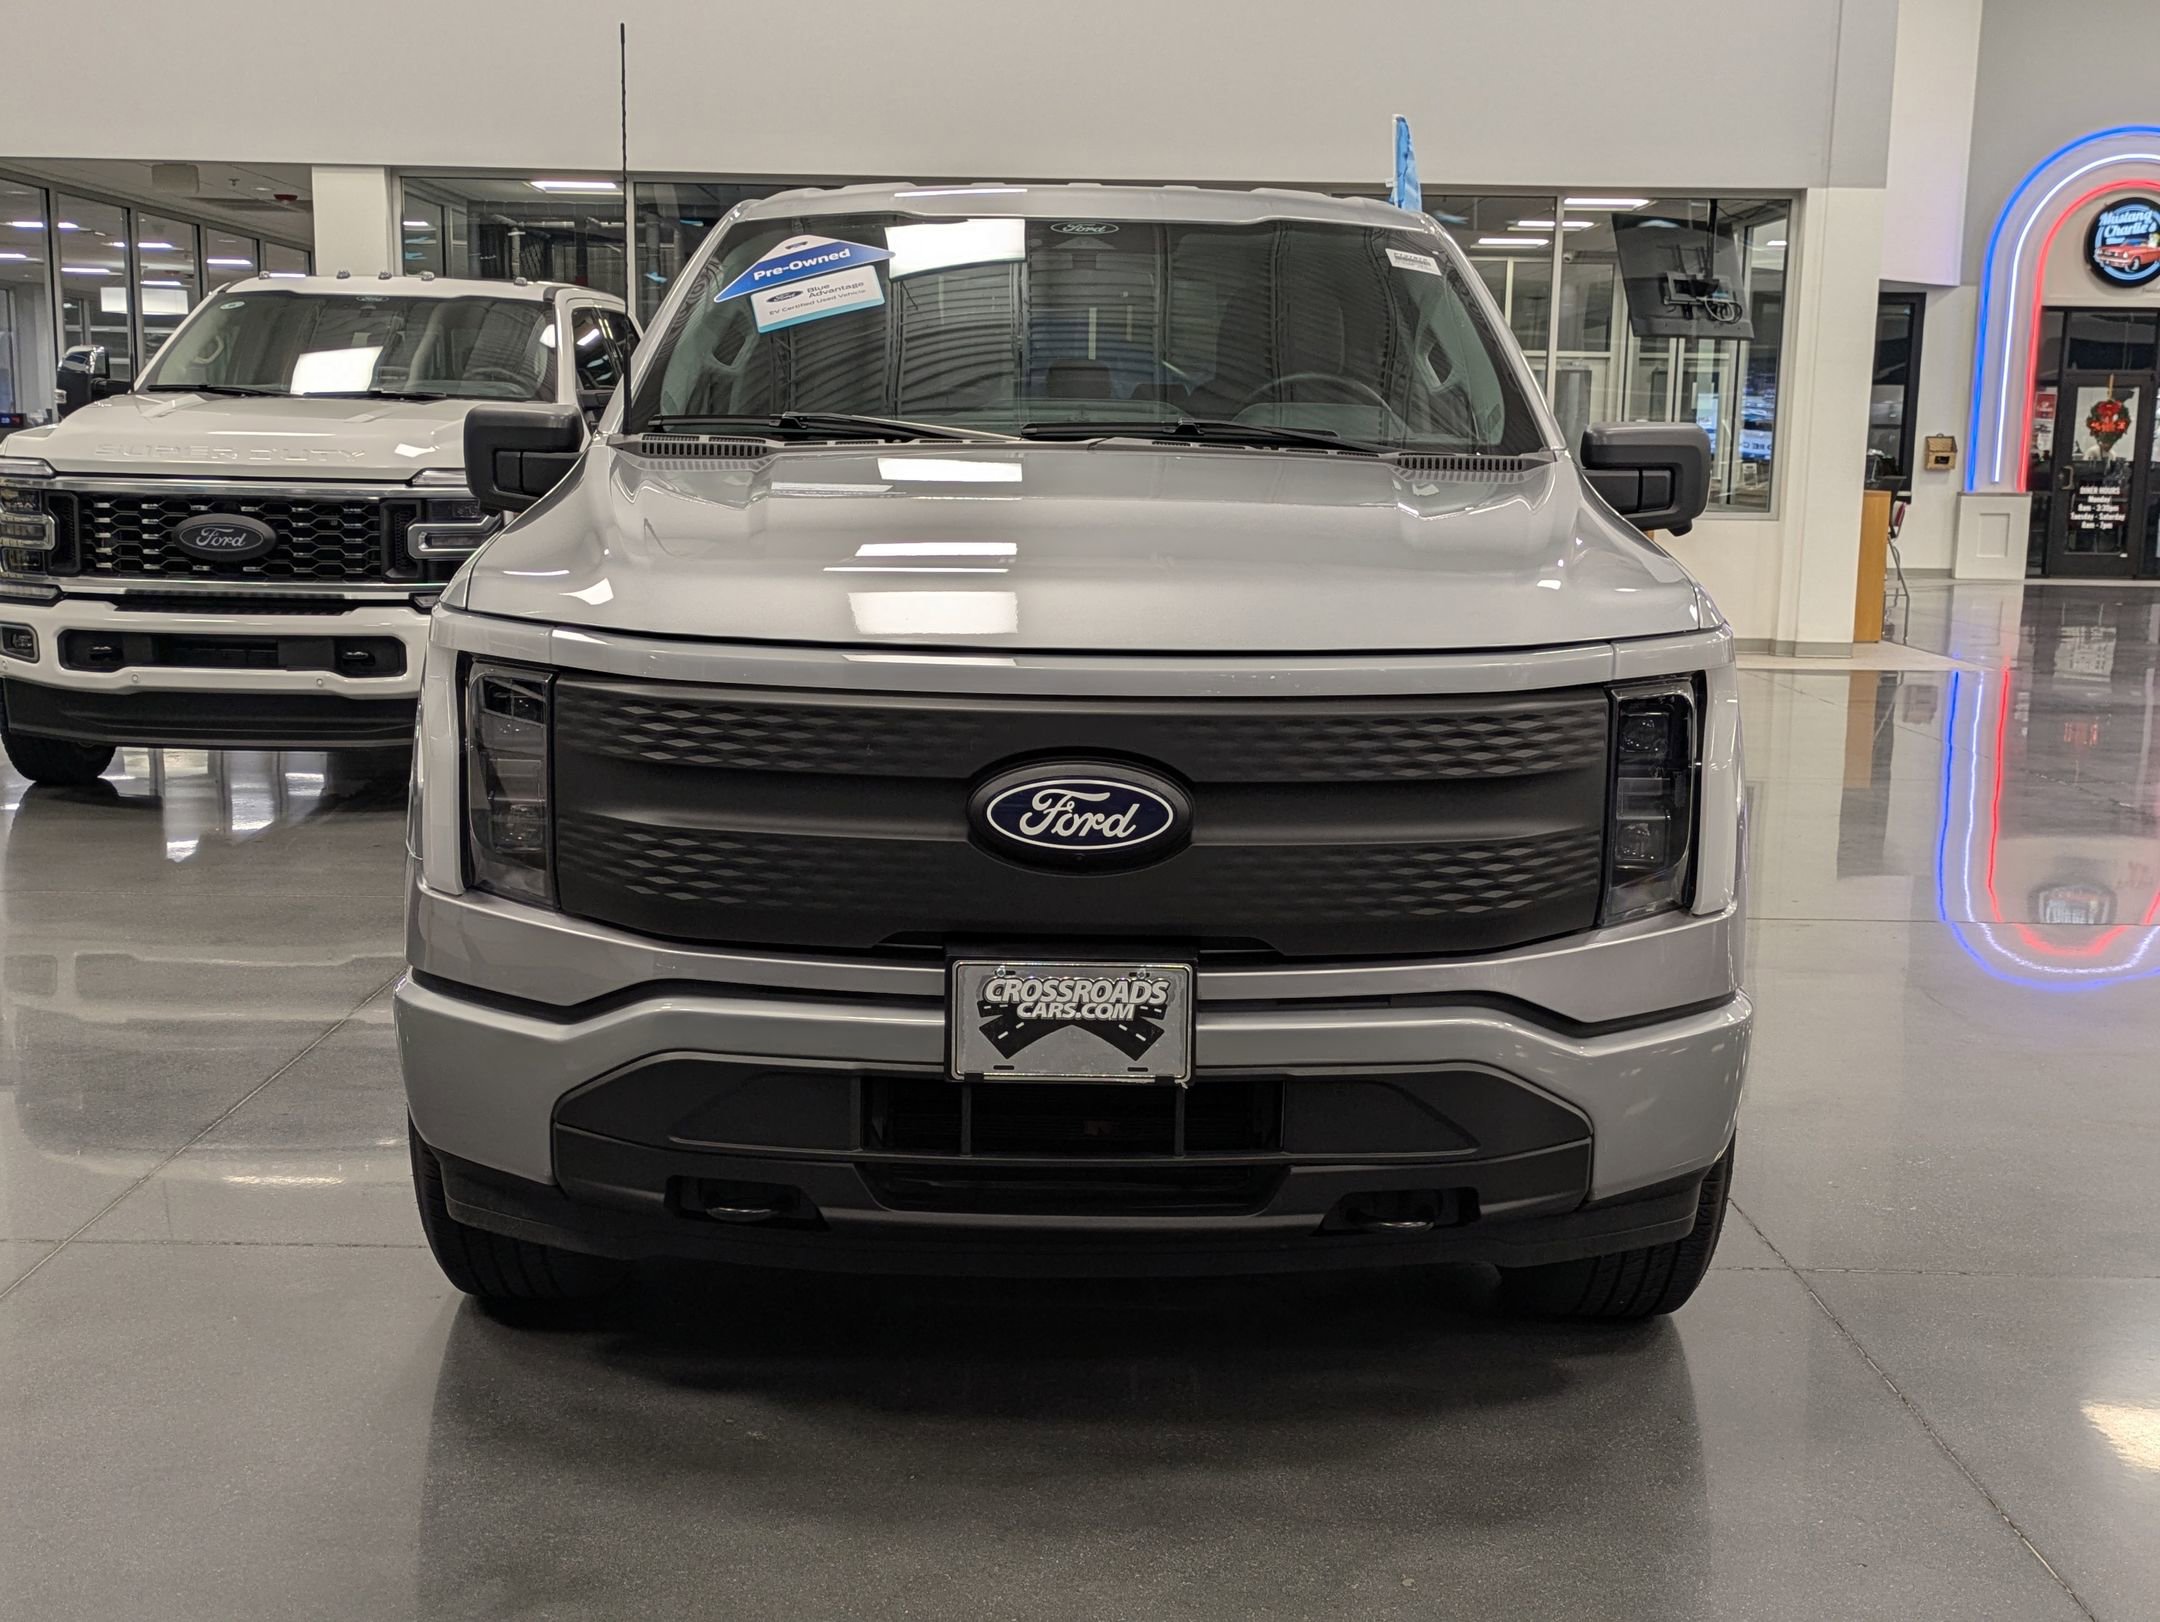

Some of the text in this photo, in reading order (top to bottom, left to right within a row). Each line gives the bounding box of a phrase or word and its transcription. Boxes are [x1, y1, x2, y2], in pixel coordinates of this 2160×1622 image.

[2099, 210, 2153, 226] Mustang
[1062, 223, 1107, 233] Ford
[2104, 221, 2157, 238] Charlie's
[753, 248, 851, 281] Pre-Owned
[807, 283, 830, 293] Blue
[808, 281, 864, 298] Advantage
[95, 444, 366, 462] SUPER DUTY
[2070, 511, 2094, 521] Tuesday
[2099, 512, 2126, 522] Saturday
[196, 527, 247, 547] Ford
[1019, 788, 1140, 838] Ford
[984, 976, 1171, 1005] CROSSROADS
[1016, 1001, 1136, 1021] CARS.COM
